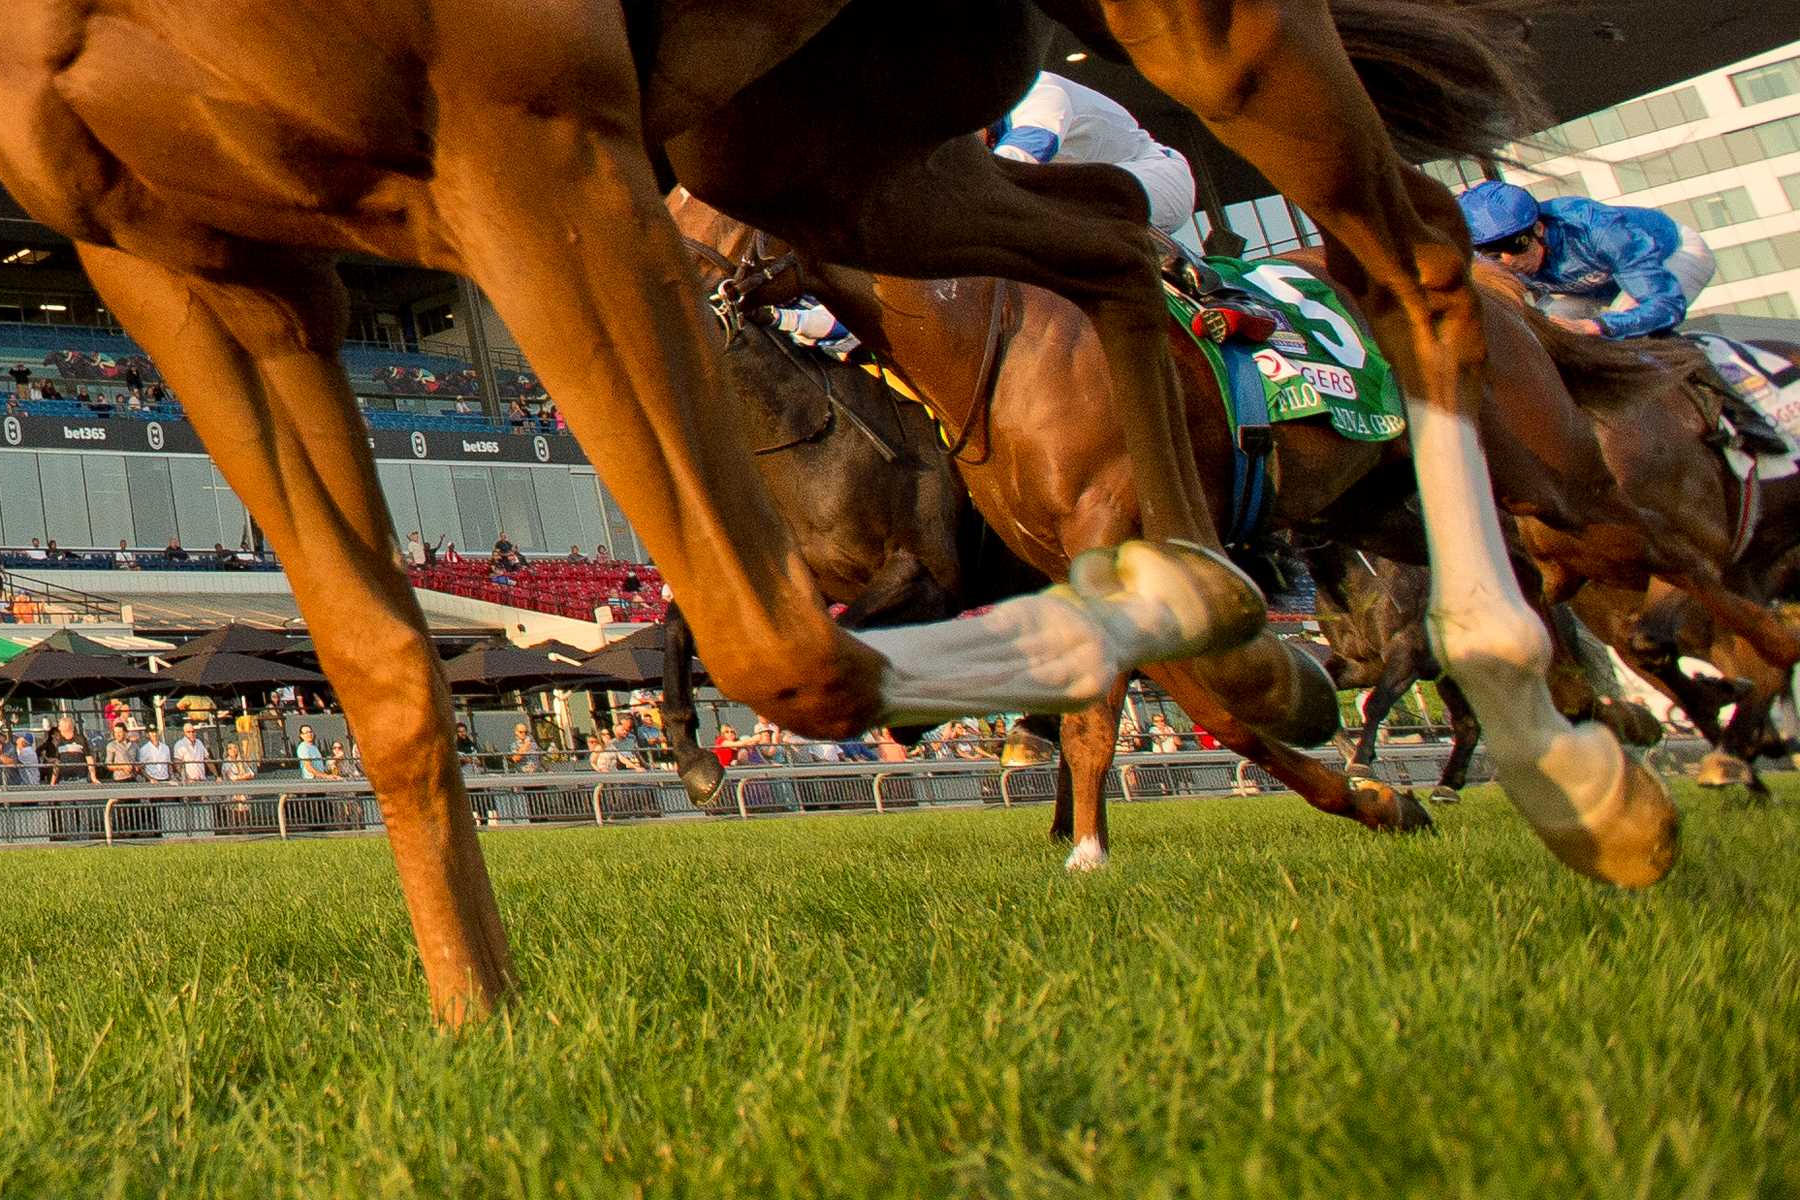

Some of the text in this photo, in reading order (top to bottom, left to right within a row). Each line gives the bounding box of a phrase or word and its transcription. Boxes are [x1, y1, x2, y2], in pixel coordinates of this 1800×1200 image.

[1242, 264, 1367, 369] 5
[1300, 366, 1354, 395] GERS
[63, 426, 106, 441] bet365
[462, 440, 499, 454] bet365
